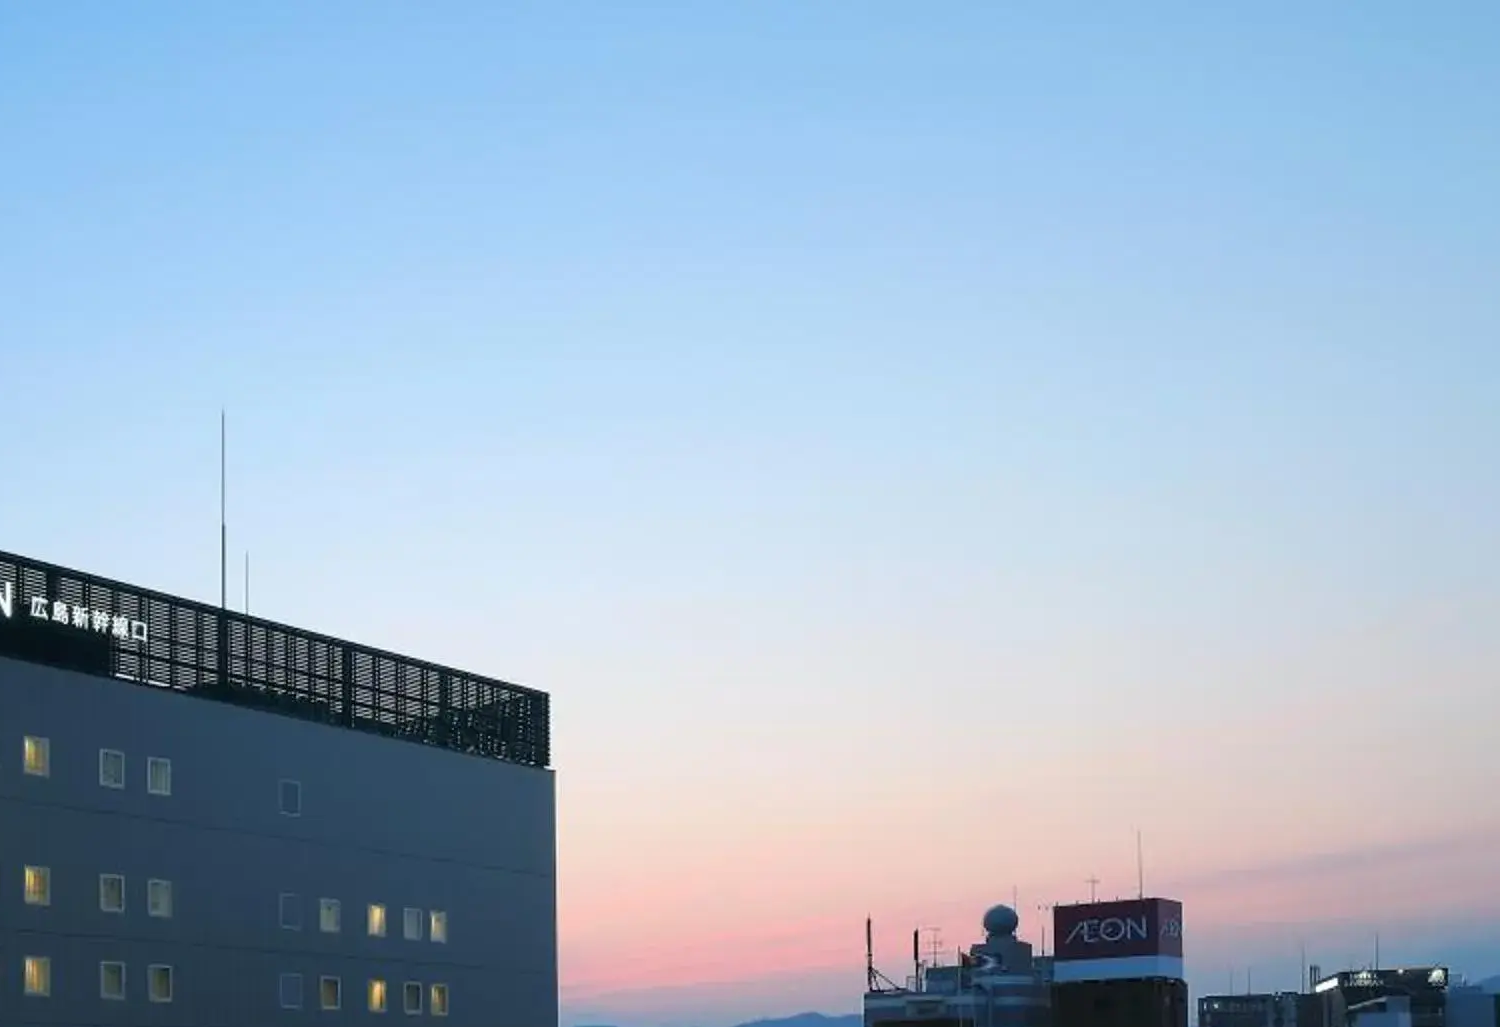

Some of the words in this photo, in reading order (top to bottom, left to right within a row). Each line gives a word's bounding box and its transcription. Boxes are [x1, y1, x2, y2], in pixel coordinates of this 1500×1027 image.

[30, 596, 148, 642] 広島新幹線口
